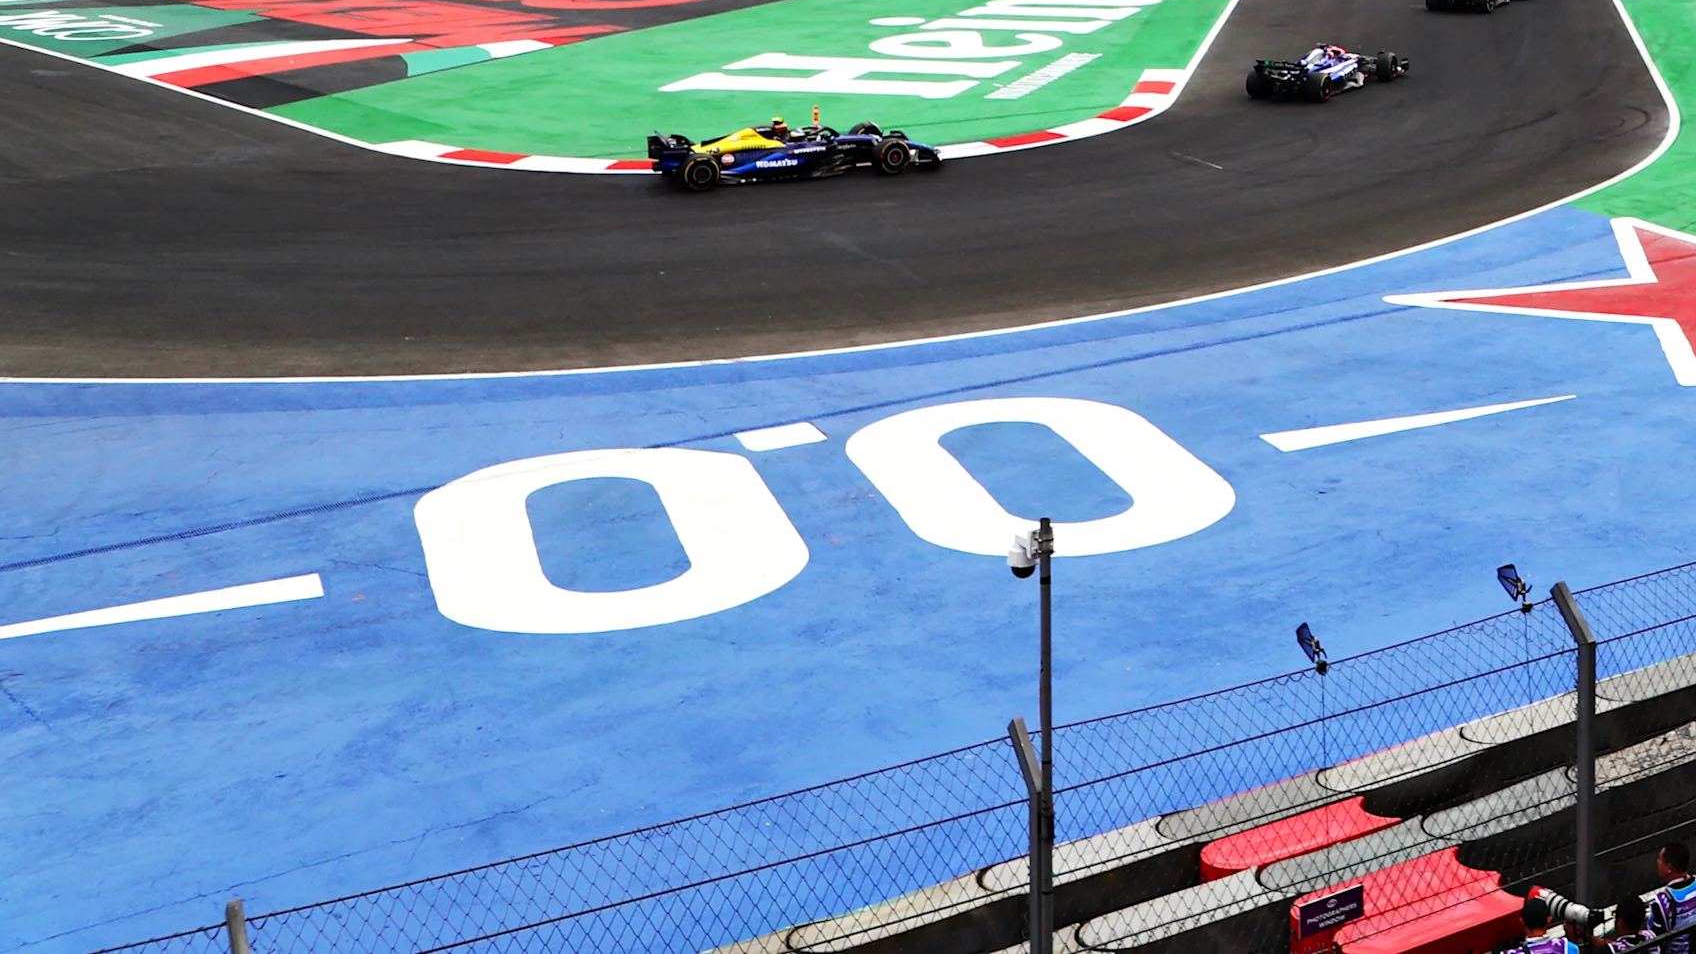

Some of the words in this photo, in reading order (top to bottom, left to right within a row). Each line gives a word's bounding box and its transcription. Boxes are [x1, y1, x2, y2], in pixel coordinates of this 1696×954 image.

[755, 159, 799, 169] KOMATSU
[1306, 902, 1358, 926] PHOTOGRAPHERS
[1318, 914, 1347, 929] WINDOW
